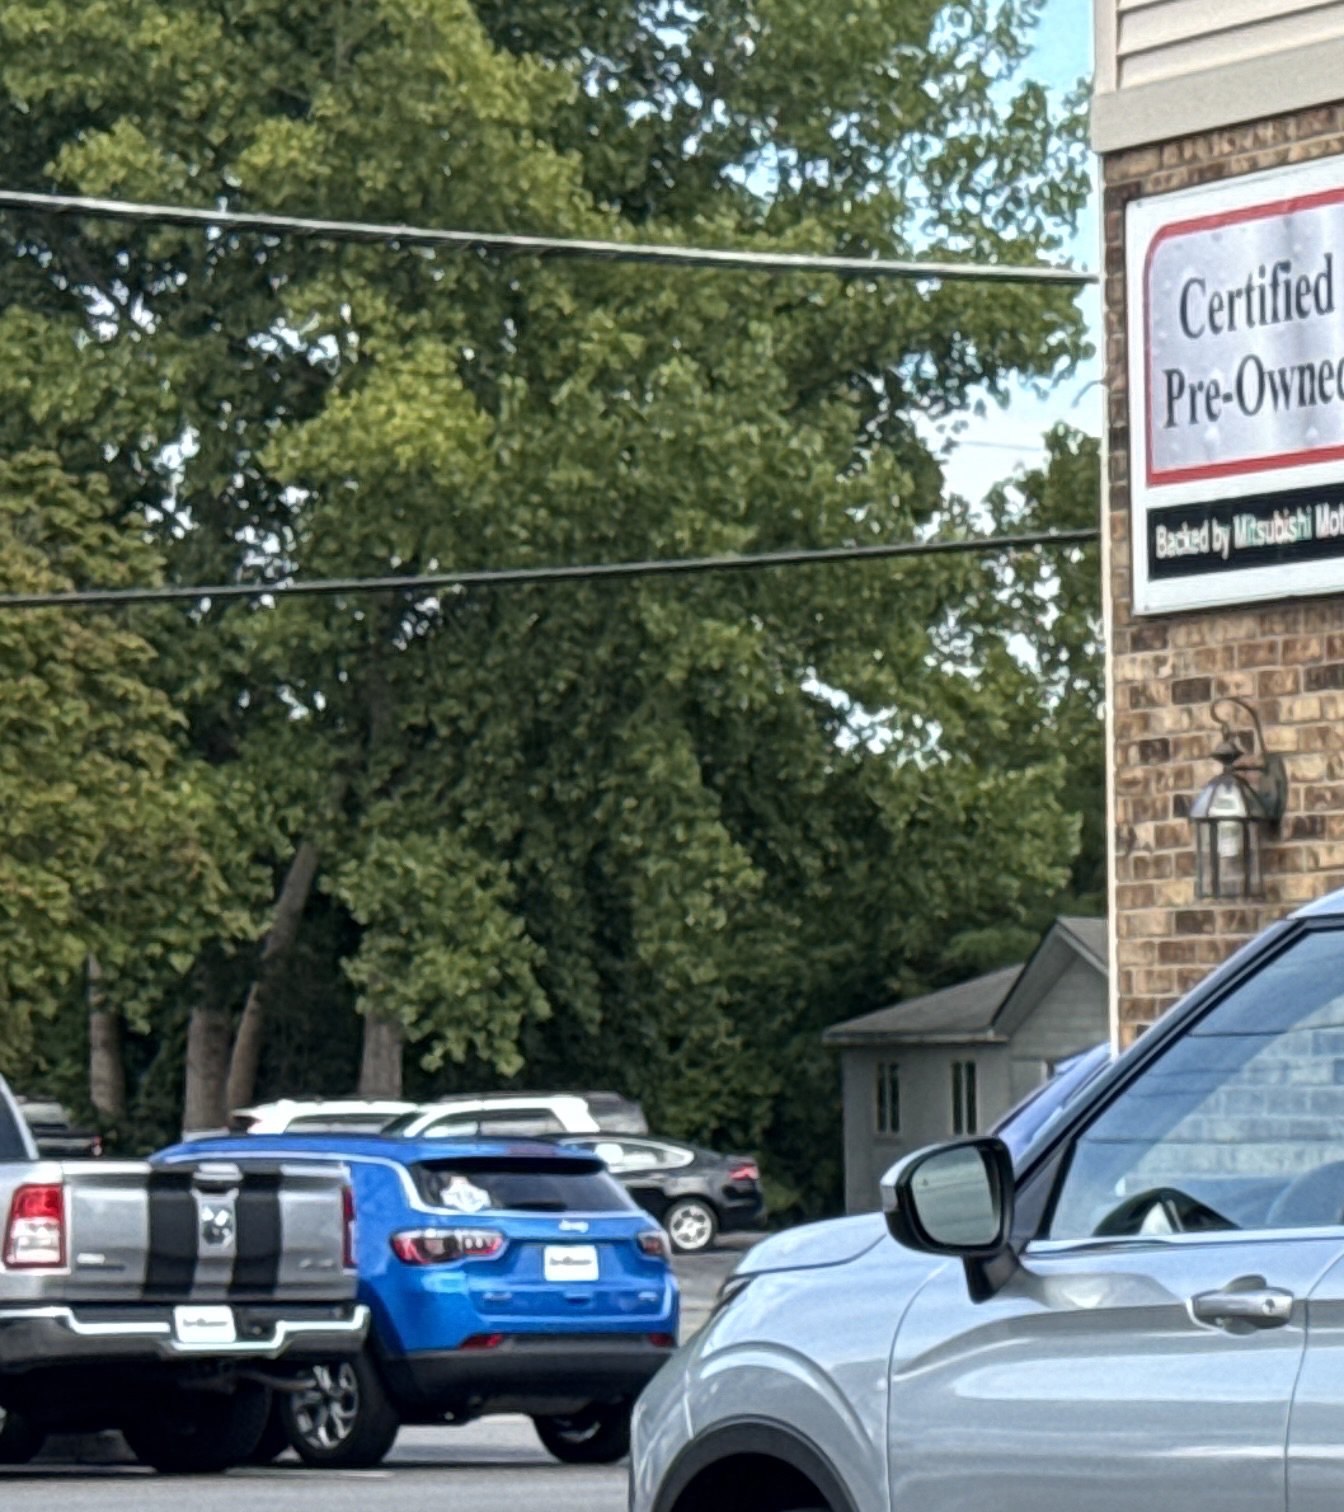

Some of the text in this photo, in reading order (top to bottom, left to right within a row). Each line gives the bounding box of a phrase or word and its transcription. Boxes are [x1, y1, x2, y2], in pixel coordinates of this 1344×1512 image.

[1179, 252, 1335, 339] Certified
[1155, 519, 1210, 559] Backed
[1211, 517, 1230, 560] by
[1233, 504, 1313, 549] Mitsubishi
